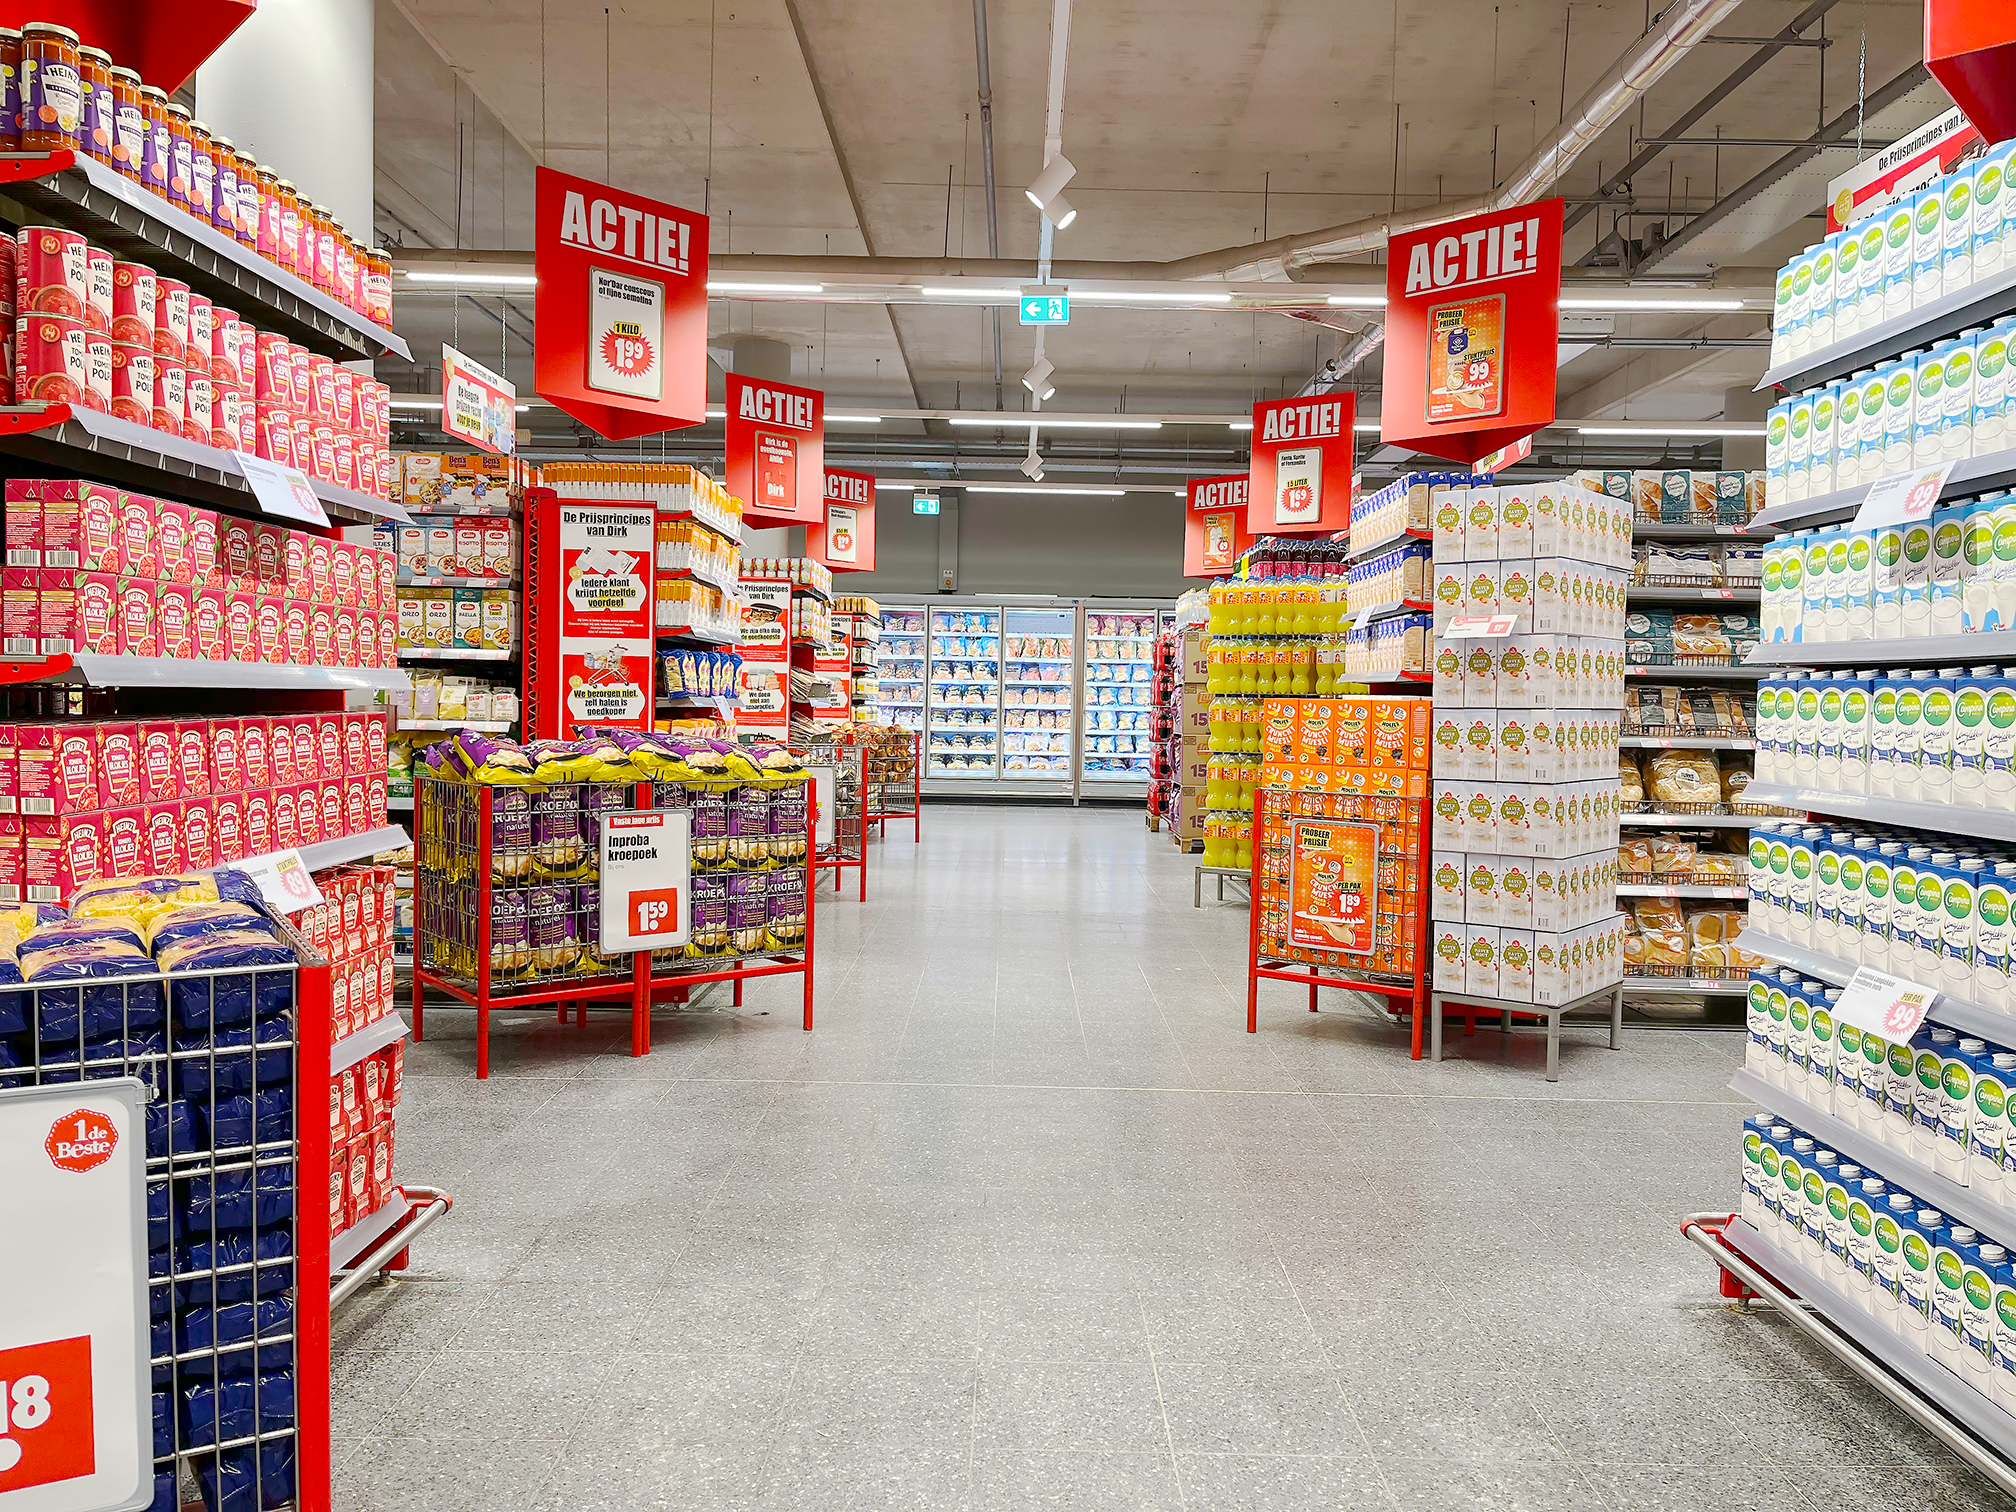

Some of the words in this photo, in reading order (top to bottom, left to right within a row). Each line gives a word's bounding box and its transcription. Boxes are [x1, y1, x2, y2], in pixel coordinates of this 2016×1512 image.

[1879, 157, 1888, 170] De
[1890, 125, 1942, 164] Prijsprincipes
[1945, 115, 1958, 132] van
[561, 190, 690, 271] ACTIE!
[1405, 218, 1539, 292] ACTIE!
[370, 274, 390, 285] HEINZ
[624, 284, 655, 297] couscous
[623, 293, 652, 305] semolina
[1437, 310, 1463, 319] PROBEER
[616, 324, 619, 332] 1
[622, 324, 639, 334] KILO
[1978, 349, 2006, 370] Campina
[1470, 362, 1489, 381] 99
[740, 385, 813, 428] ACTIE!
[1263, 402, 1341, 440] ACTIE!
[449, 456, 466, 464] Ben's
[767, 483, 784, 497] Dirk
[1195, 481, 1248, 507] ACTIE!
[1908, 484, 1934, 509] 99
[564, 512, 576, 522] De
[580, 513, 650, 525] Prijsprincipes
[587, 526, 604, 536] van
[607, 526, 627, 536] Dirk
[1905, 539, 1927, 554] Campina
[582, 579, 607, 587] Iedere
[88, 588, 106, 598] HEINZ
[576, 589, 597, 598] krijgt
[599, 588, 636, 597] hetzelfde
[588, 598, 623, 607] voordeel
[588, 690, 620, 698] bezorgen
[599, 699, 619, 707] halen
[587, 708, 626, 716] goedkoper
[1957, 702, 1983, 717] Campina
[1300, 726, 1330, 738] CRUNCHY
[1336, 727, 1368, 739] CRUNCHY
[1374, 728, 1407, 741] CRUNCHY
[1302, 736, 1329, 745] MUESLI
[1337, 737, 1365, 747] MUESLI
[1376, 738, 1404, 748] MUESLI
[66, 742, 84, 753] HEINZ
[74, 828, 92, 839] HEINZ
[115, 823, 133, 833] HEINZ
[1301, 827, 1330, 839] PROBEER
[609, 835, 649, 847] Inproba
[1304, 837, 1327, 847] PRIJSJE
[608, 847, 657, 861] kroepoek
[286, 870, 305, 894] 89
[1980, 898, 2007, 915] Campina
[1888, 1005, 1915, 1029] 99
[1889, 1050, 1912, 1065] Campina
[74, 1119, 86, 1142] 1
[88, 1126, 108, 1141] de
[56, 1140, 110, 1159] Beste
[1904, 1242, 1928, 1260] Campina
[1964, 1277, 1991, 1297] Campina
